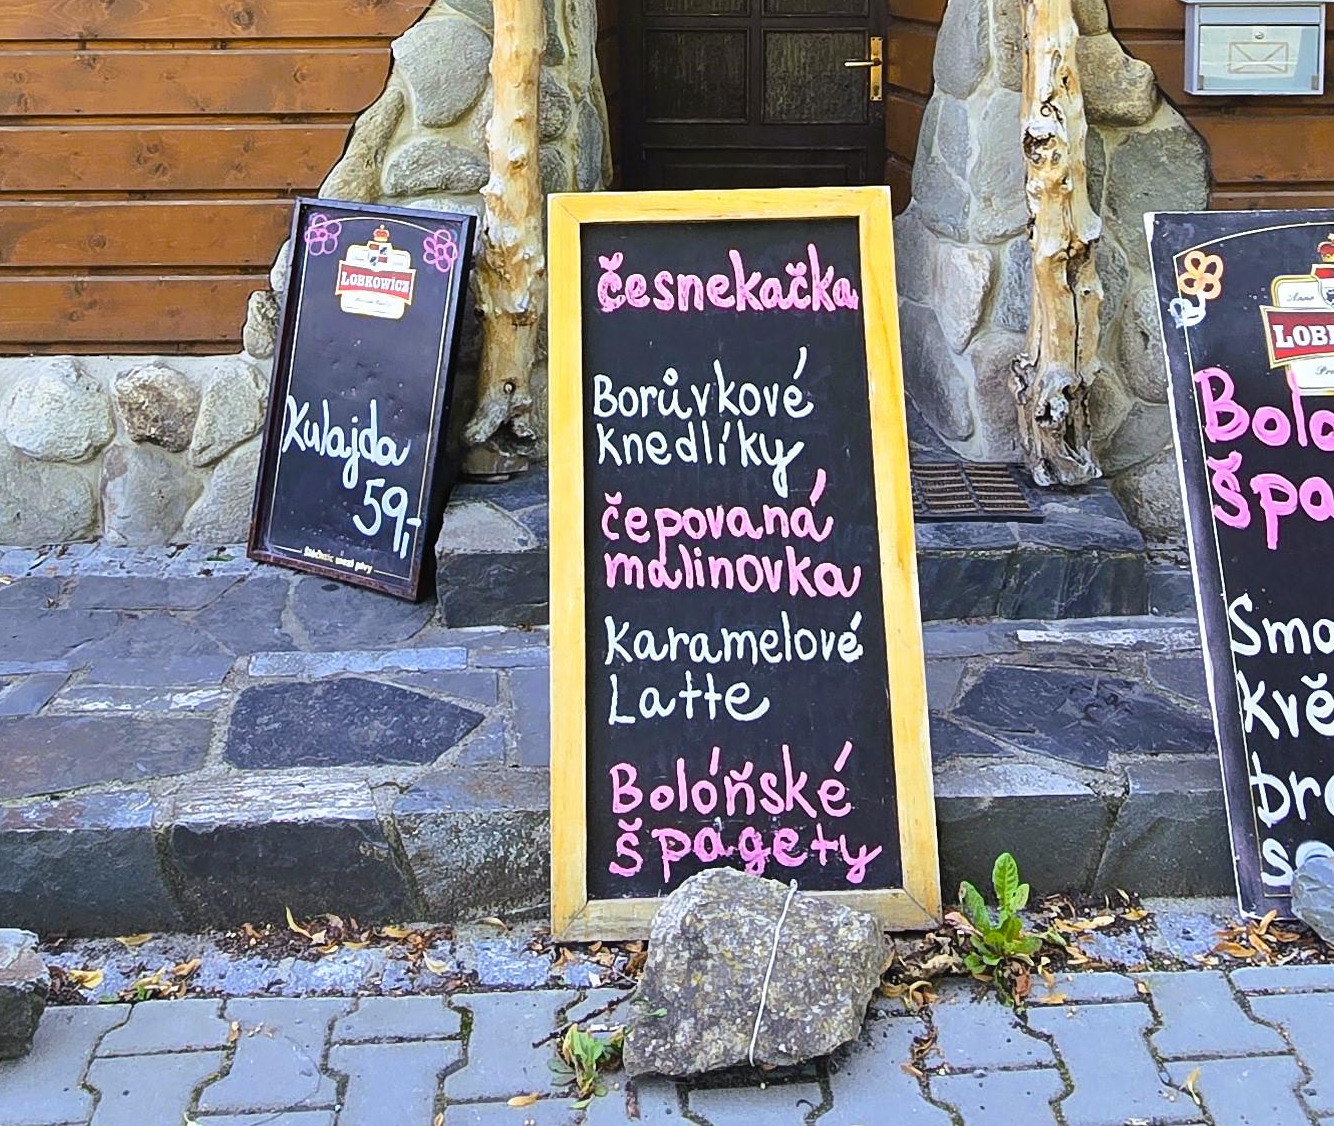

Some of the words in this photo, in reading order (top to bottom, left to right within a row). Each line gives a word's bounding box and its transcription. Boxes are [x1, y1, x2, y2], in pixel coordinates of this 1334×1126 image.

[341, 271, 410, 293] LOBKOWICZ
[593, 346, 815, 419] Borůvkové
[282, 394, 412, 489] Kulajda
[604, 544, 862, 598] malinovka
[604, 610, 864, 665] Karamelové
[609, 670, 770, 725] Latte
